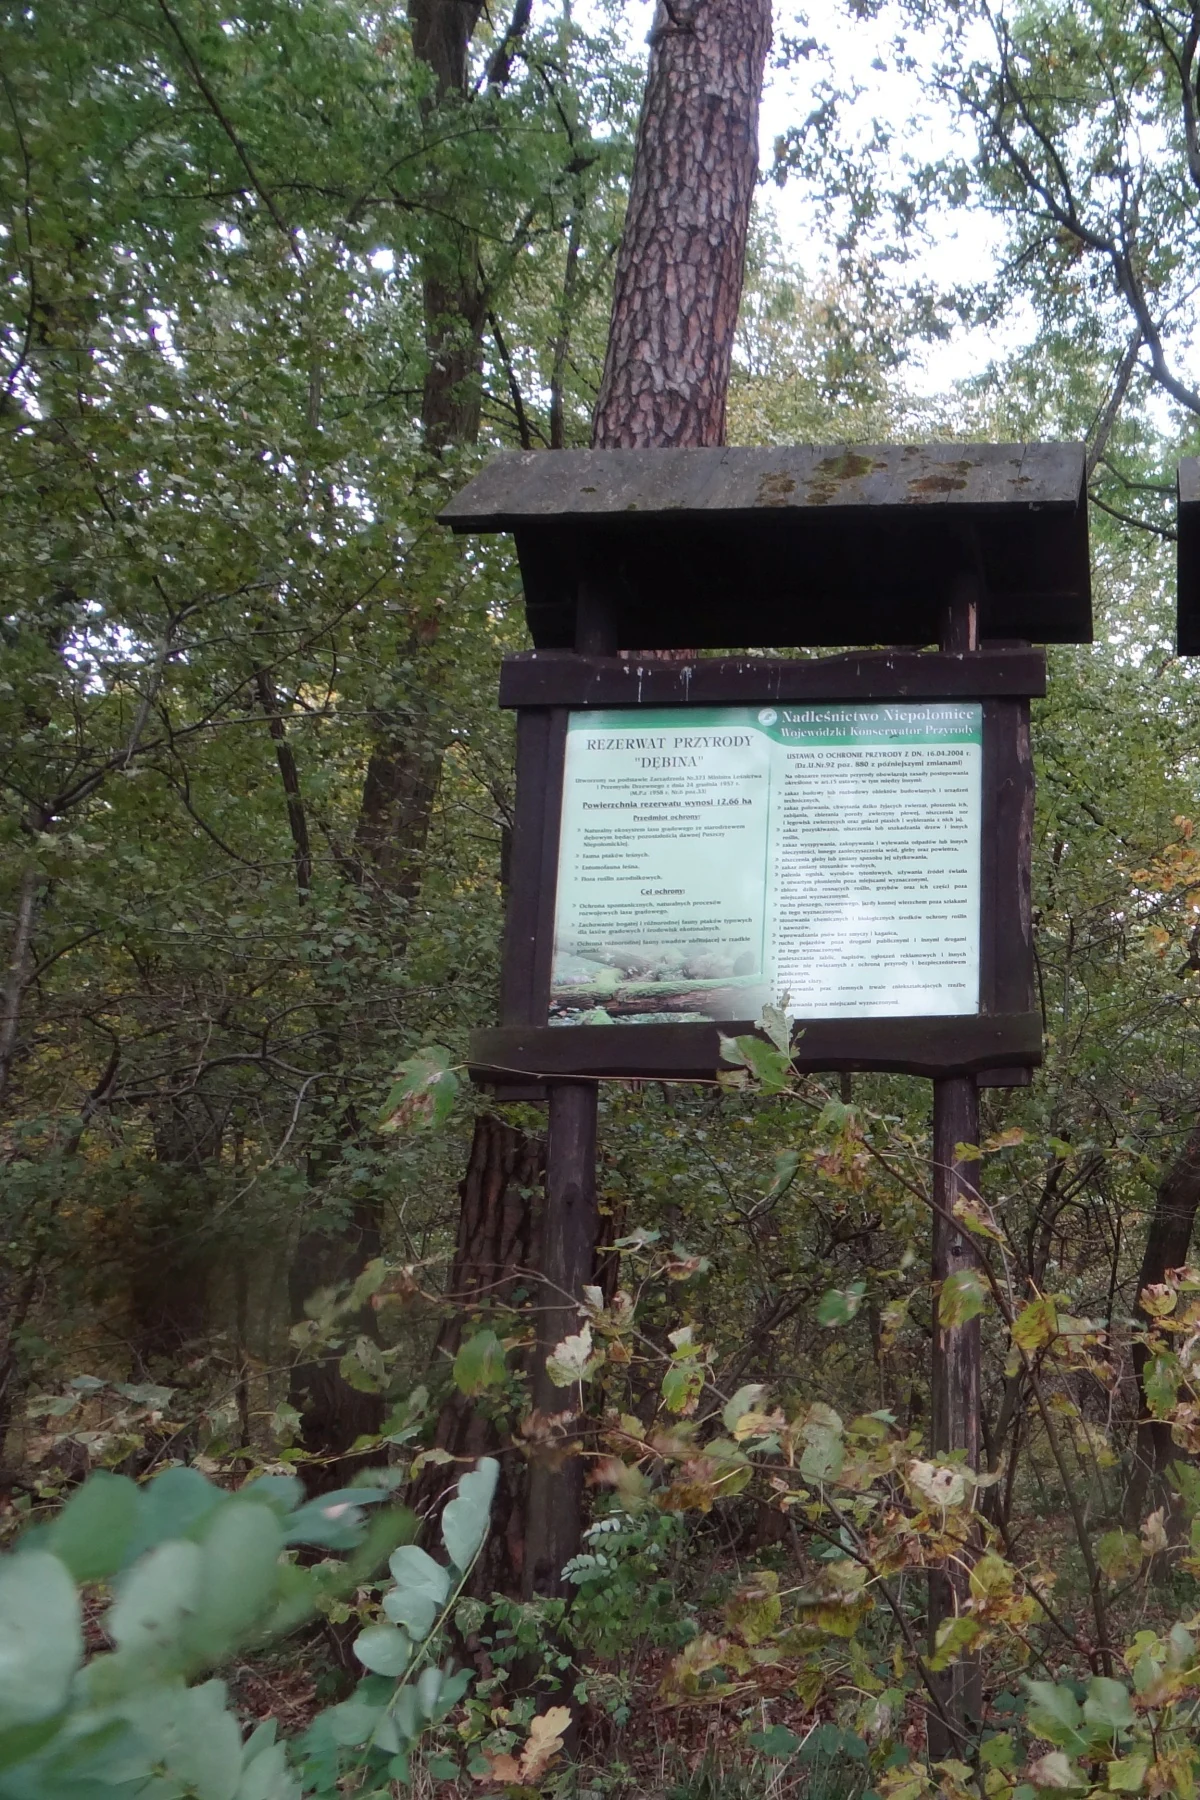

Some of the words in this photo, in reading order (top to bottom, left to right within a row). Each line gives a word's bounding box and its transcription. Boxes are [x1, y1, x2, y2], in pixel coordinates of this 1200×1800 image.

[783, 710, 879, 722] Nadleśnictwo
[884, 709, 974, 721] Niepołomice
[781, 727, 846, 738] Wojewódzki
[850, 726, 921, 736] Konserwator
[925, 725, 973, 736] Przyrody
[587, 738, 667, 751] REZERWAT
[674, 736, 754, 748] PRZYRODY
[635, 756, 704, 770] "DĘBINA"
[878, 760, 924, 768] późniejszymi
